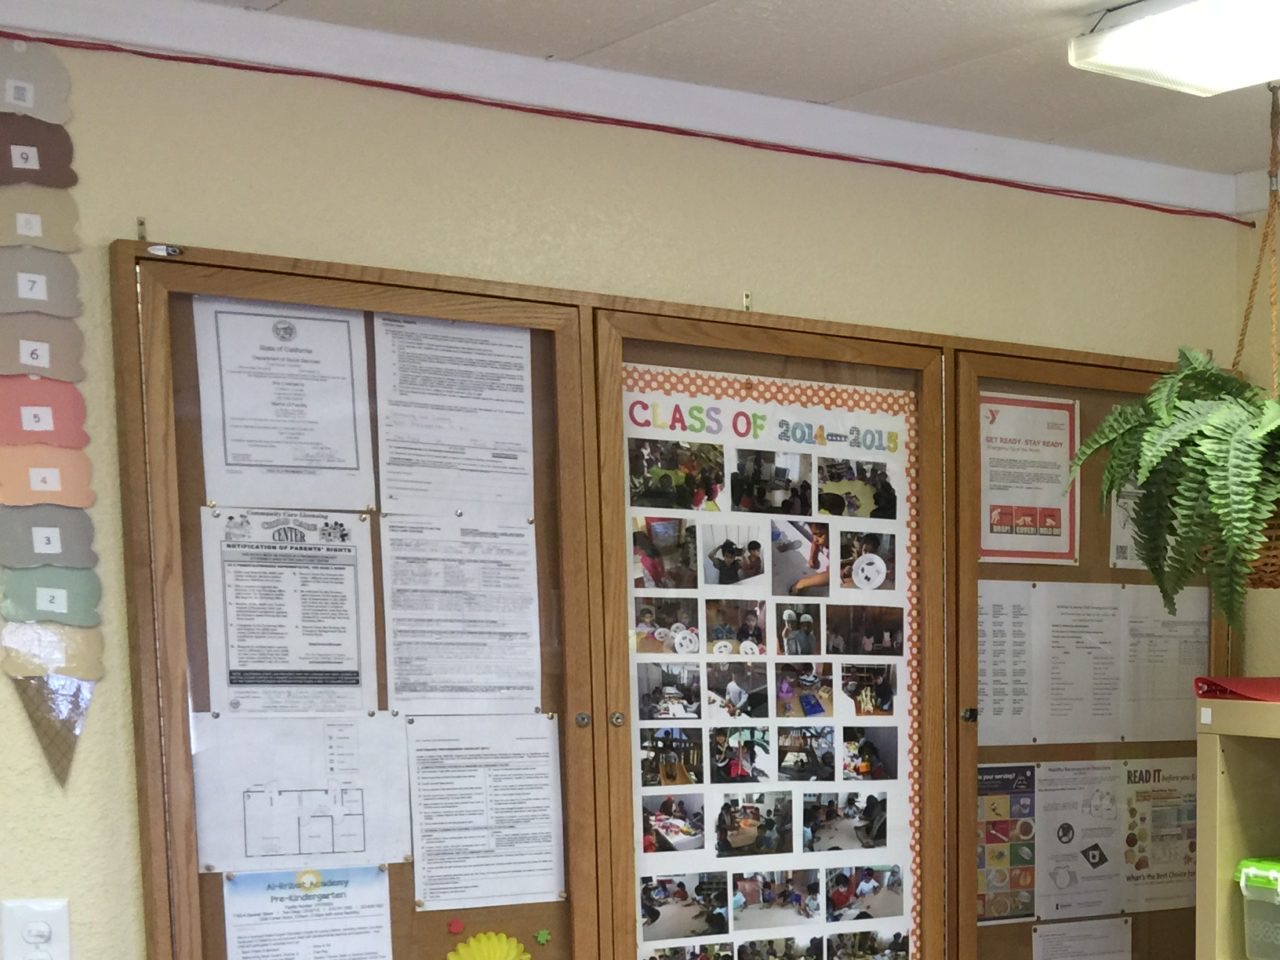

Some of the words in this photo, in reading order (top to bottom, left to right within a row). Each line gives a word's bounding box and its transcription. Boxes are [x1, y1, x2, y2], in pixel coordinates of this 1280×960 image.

[20, 152, 29, 164] 9
[27, 279, 37, 291] 7
[30, 349, 39, 360] 6
[33, 413, 40, 423] 5
[628, 400, 723, 435] CLASS
[732, 411, 768, 439] OF
[40, 476, 48, 485] 4
[272, 526, 306, 543] CENTER
[44, 536, 51, 545] 3
[226, 543, 277, 551] NOTIFICATION
[48, 595, 56, 604] 2
[1126, 769, 1152, 785] READ
[1152, 768, 1162, 784] IT
